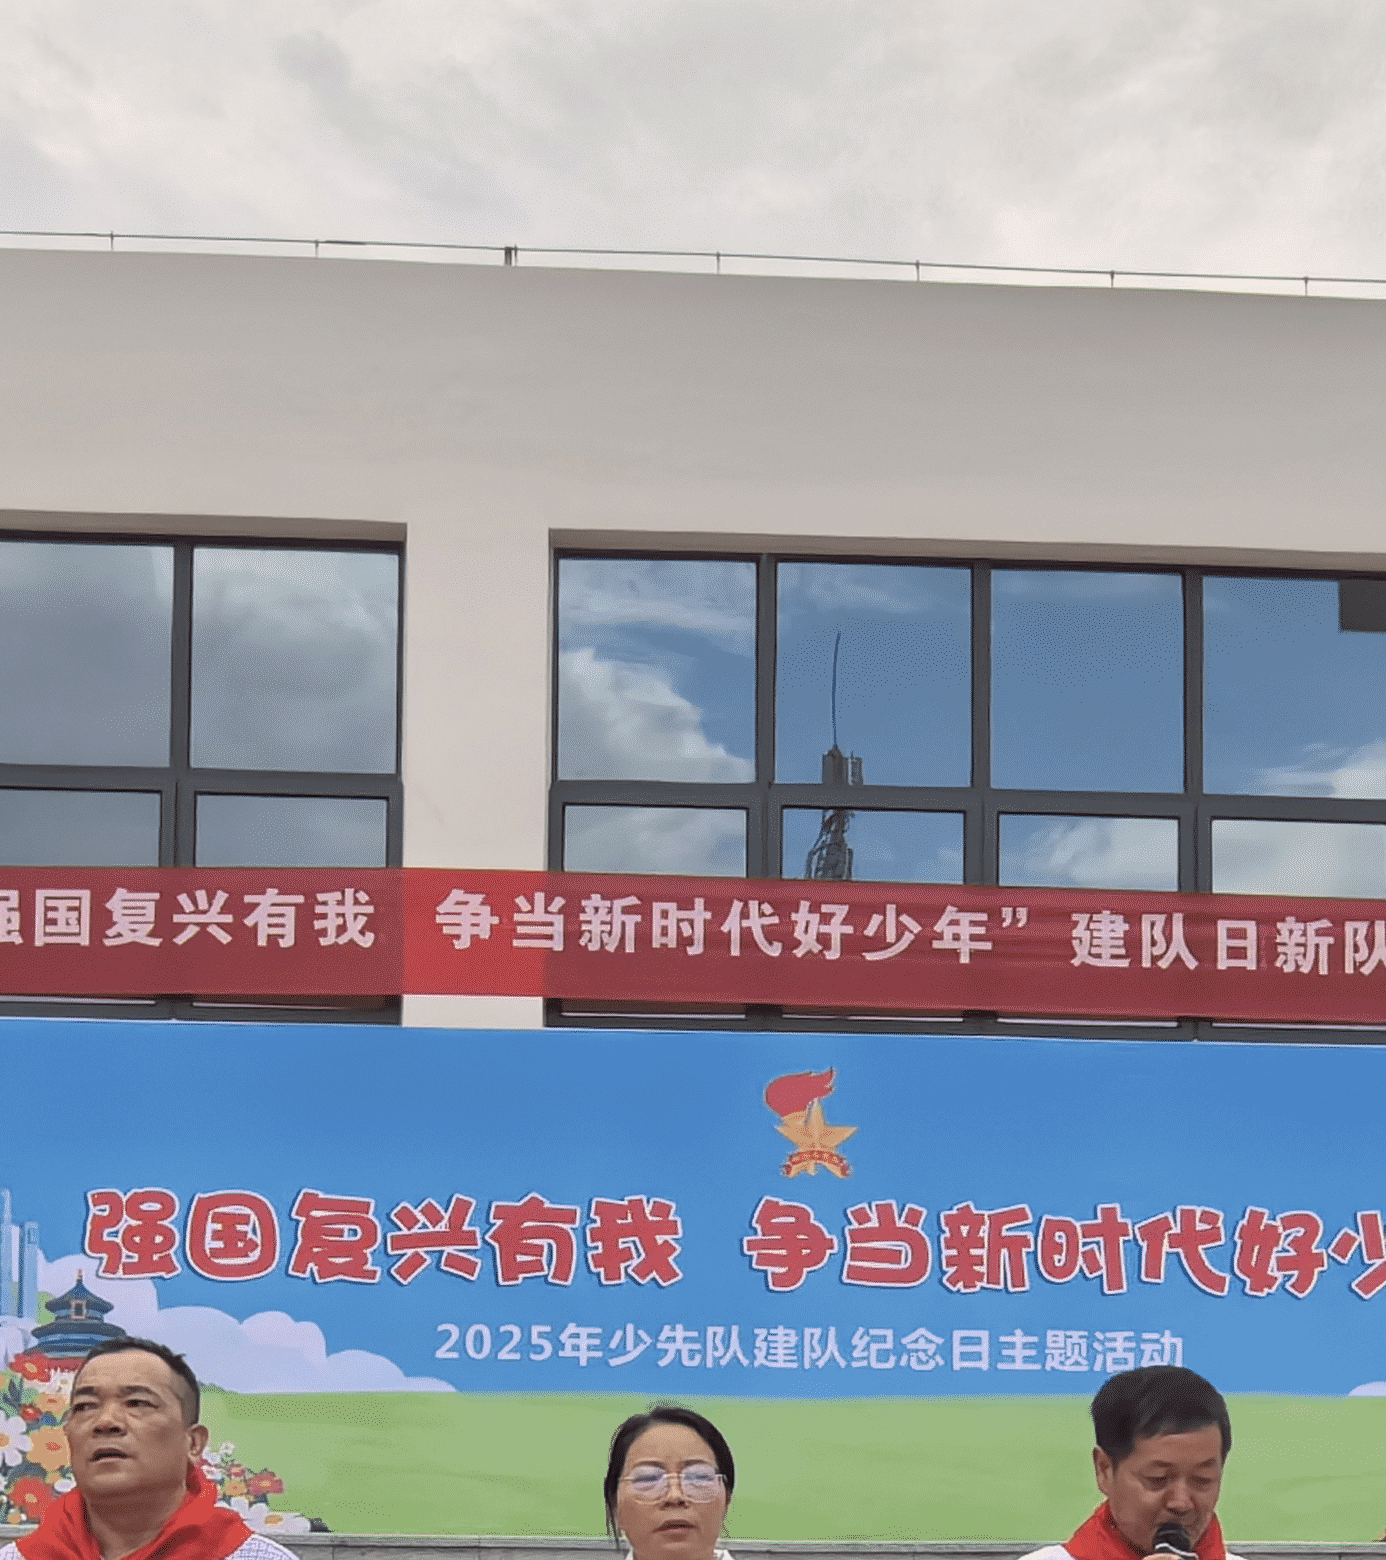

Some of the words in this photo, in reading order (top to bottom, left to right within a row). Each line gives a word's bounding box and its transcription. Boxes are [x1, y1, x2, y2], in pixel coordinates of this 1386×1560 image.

[434, 889, 1029, 964] 争当新时代好少年”
[84, 1188, 683, 1286] 强国复兴有我
[433, 1322, 1184, 1374] 2025年少先队建队纪念日主题活动
